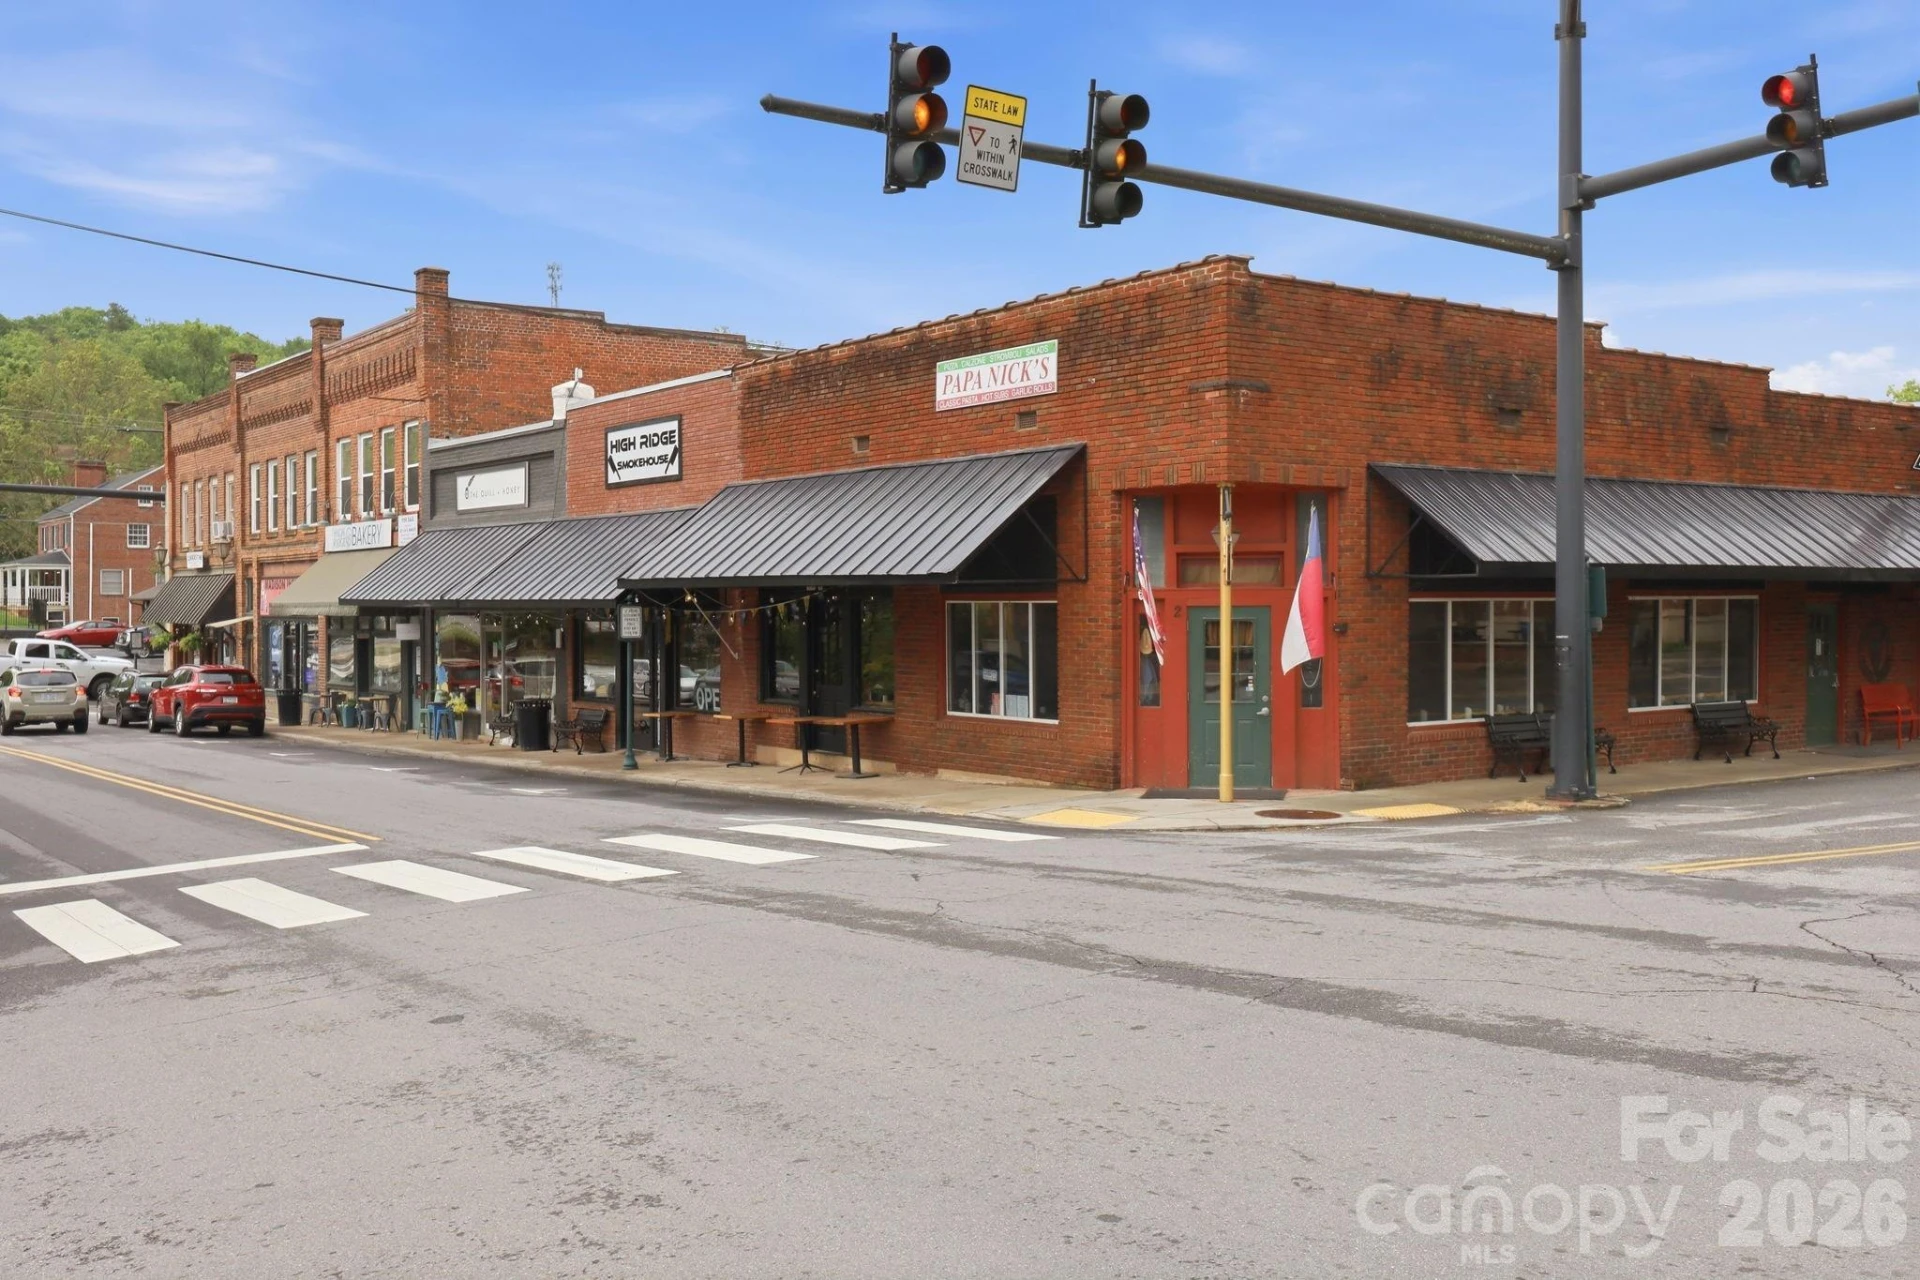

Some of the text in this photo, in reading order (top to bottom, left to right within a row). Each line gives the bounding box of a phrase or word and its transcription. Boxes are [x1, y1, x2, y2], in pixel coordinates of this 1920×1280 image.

[973, 97, 1019, 117] STATE LAW
[990, 137, 1001, 149] TO
[976, 149, 1005, 165] WITHIN
[963, 162, 1014, 182] CROSSWALK
[961, 355, 986, 368] CALZONE
[989, 351, 1022, 362] STROMBOLI
[1026, 345, 1049, 355] SALADS
[942, 356, 1050, 396] PAPA NICK'S
[939, 383, 1053, 408] CLASSIC PASTA HOT SUBS GARLIC ROLLS
[610, 429, 677, 455] HIGH RIDGE
[616, 453, 669, 471] SMOKEHOUSE
[351, 523, 383, 546] BAKERY
[1174, 606, 1182, 618] 2
[696, 687, 721, 711] OPE
